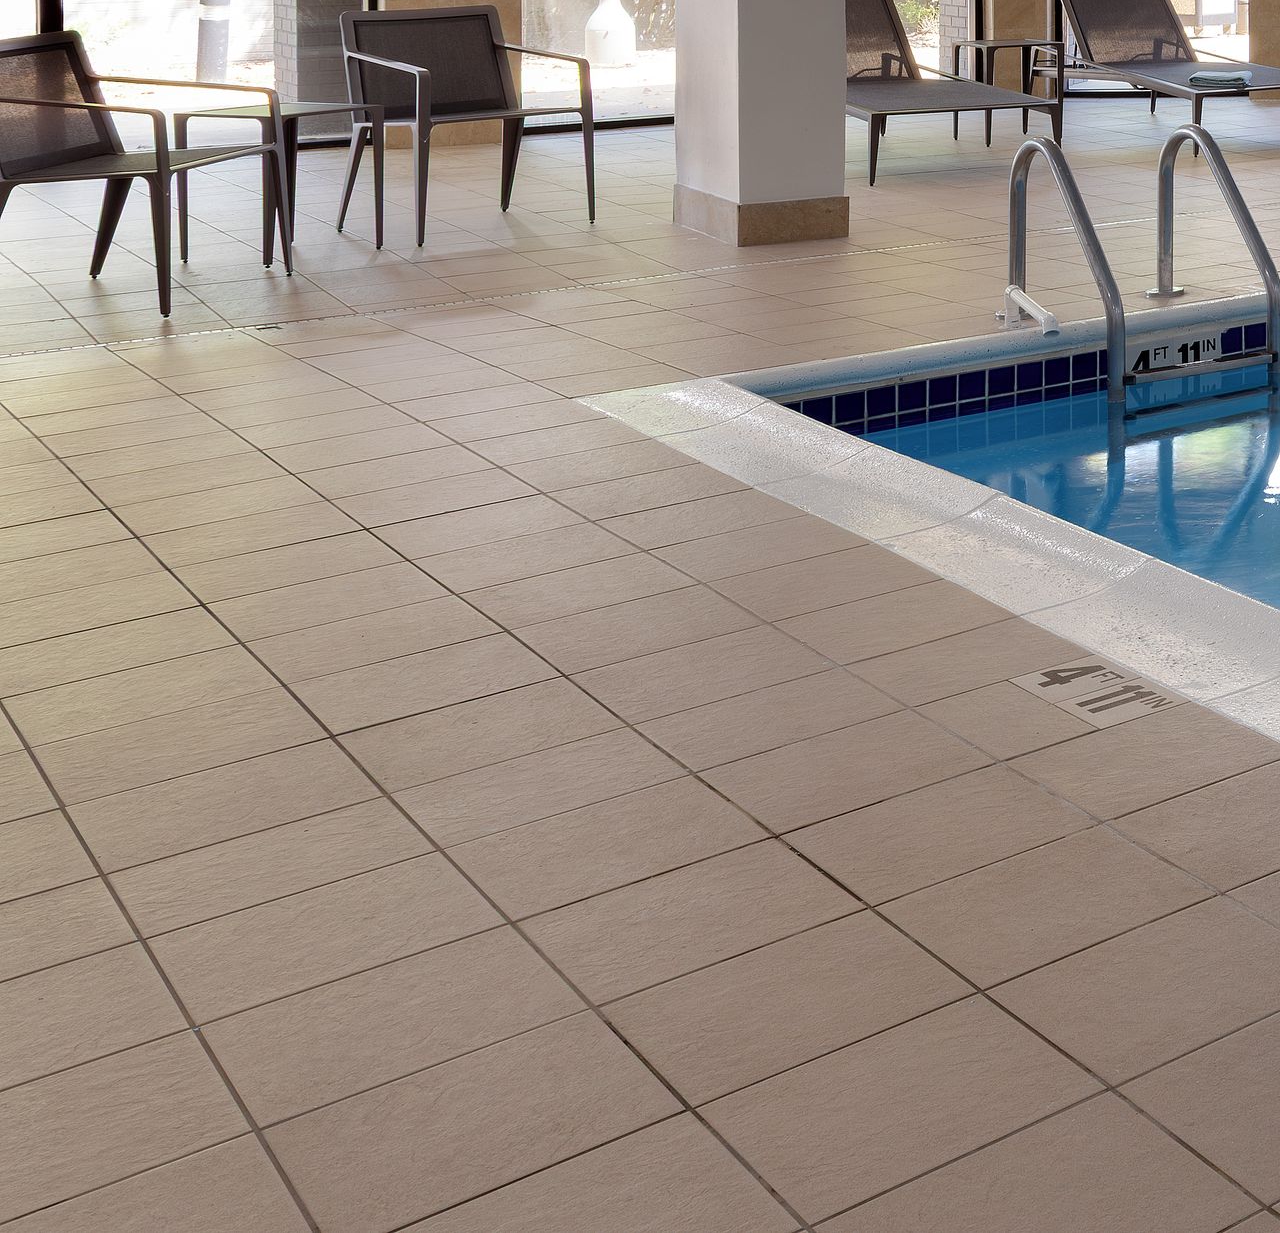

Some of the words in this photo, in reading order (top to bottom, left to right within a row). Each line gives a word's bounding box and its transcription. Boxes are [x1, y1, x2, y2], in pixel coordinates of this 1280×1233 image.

[1131, 349, 1150, 373] 4
[1153, 346, 1169, 361] FT
[1177, 340, 1201, 365] 11
[1202, 337, 1216, 352] IN
[1038, 665, 1106, 688] 4
[1091, 671, 1125, 683] FT
[1076, 685, 1157, 714] 11
[1140, 695, 1173, 709] IN
